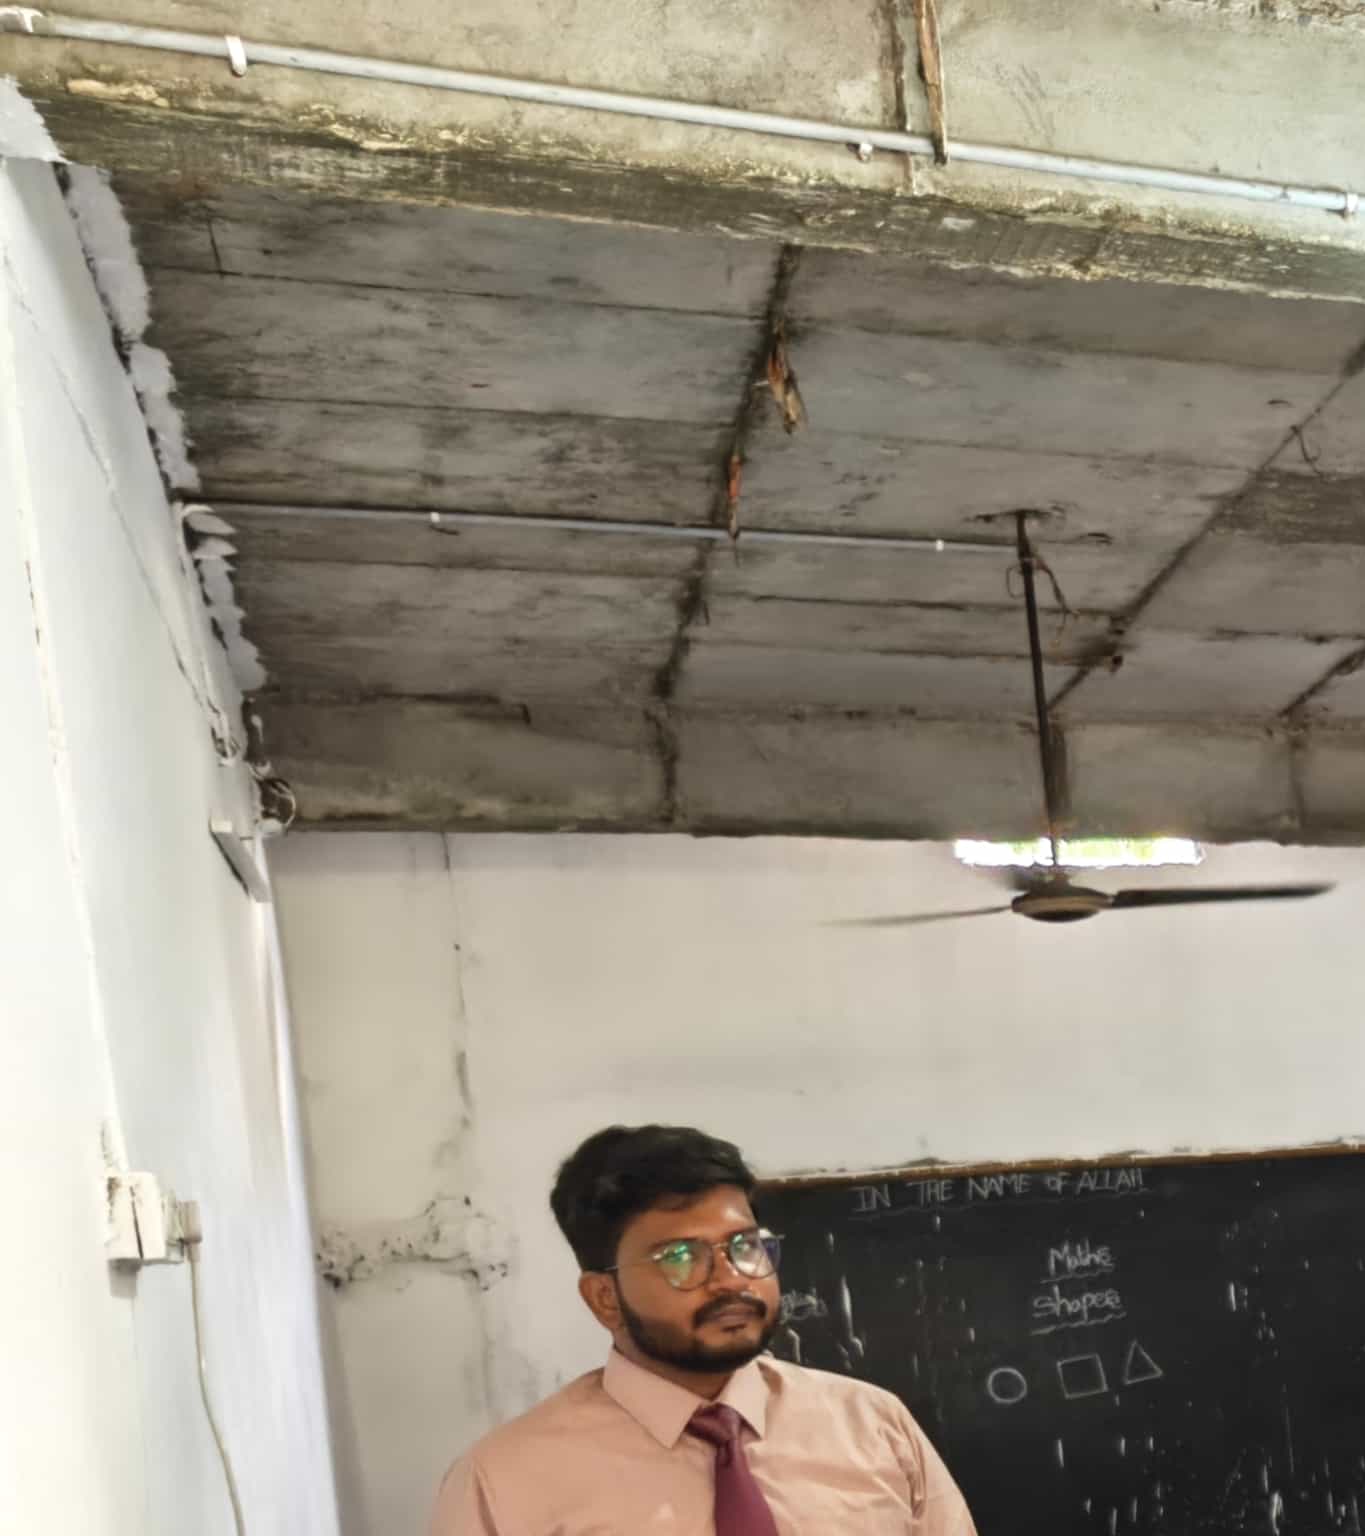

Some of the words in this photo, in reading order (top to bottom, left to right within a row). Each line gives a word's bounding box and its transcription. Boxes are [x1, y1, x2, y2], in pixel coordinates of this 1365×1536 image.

[853, 1183, 891, 1212] IN
[907, 1179, 953, 1204] THE
[967, 1173, 1032, 1199] NAME
